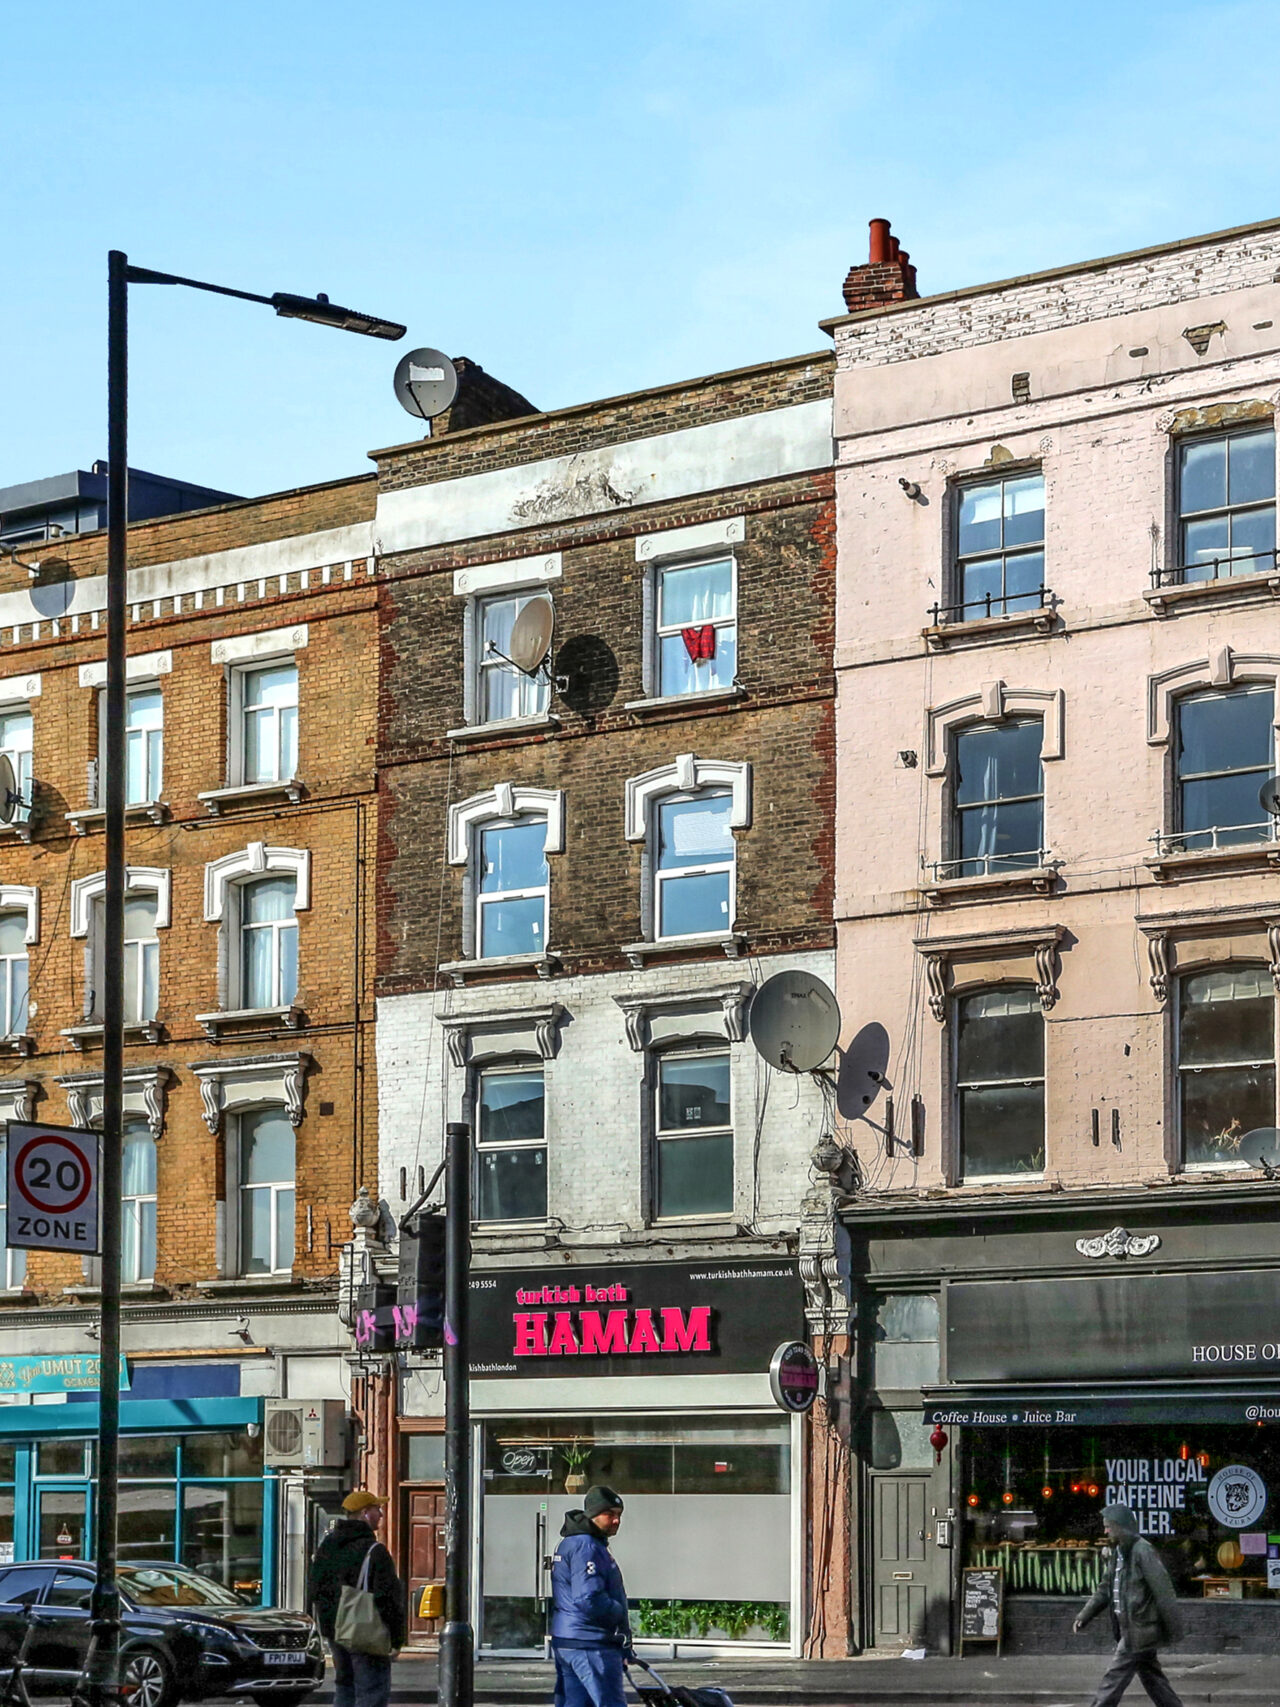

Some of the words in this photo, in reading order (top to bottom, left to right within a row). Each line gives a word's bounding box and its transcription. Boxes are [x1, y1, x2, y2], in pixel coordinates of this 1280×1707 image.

[28, 1157, 81, 1192] 20
[17, 1216, 87, 1241] ZONE
[689, 1267, 794, 1280] www.turkishbathhamam.co.uk
[480, 1280, 497, 1289] 5554
[515, 1284, 581, 1305] turkish
[585, 1282, 628, 1303] bath
[513, 1306, 712, 1356] HAMAM
[1192, 1343, 1257, 1362] HOUSE
[42, 1359, 82, 1376] UMUT
[468, 1362, 517, 1372] kishbathlondon
[932, 1411, 969, 1423] Coffee
[972, 1411, 1007, 1423] House
[1022, 1410, 1052, 1423] Juice
[1055, 1410, 1077, 1422] Bar
[503, 1451, 535, 1469] Open
[1105, 1458, 1150, 1483] YOUR
[1154, 1458, 1208, 1482] LOCAL
[1105, 1484, 1186, 1509] CAFFEINE
[1132, 1510, 1176, 1535] LER.
